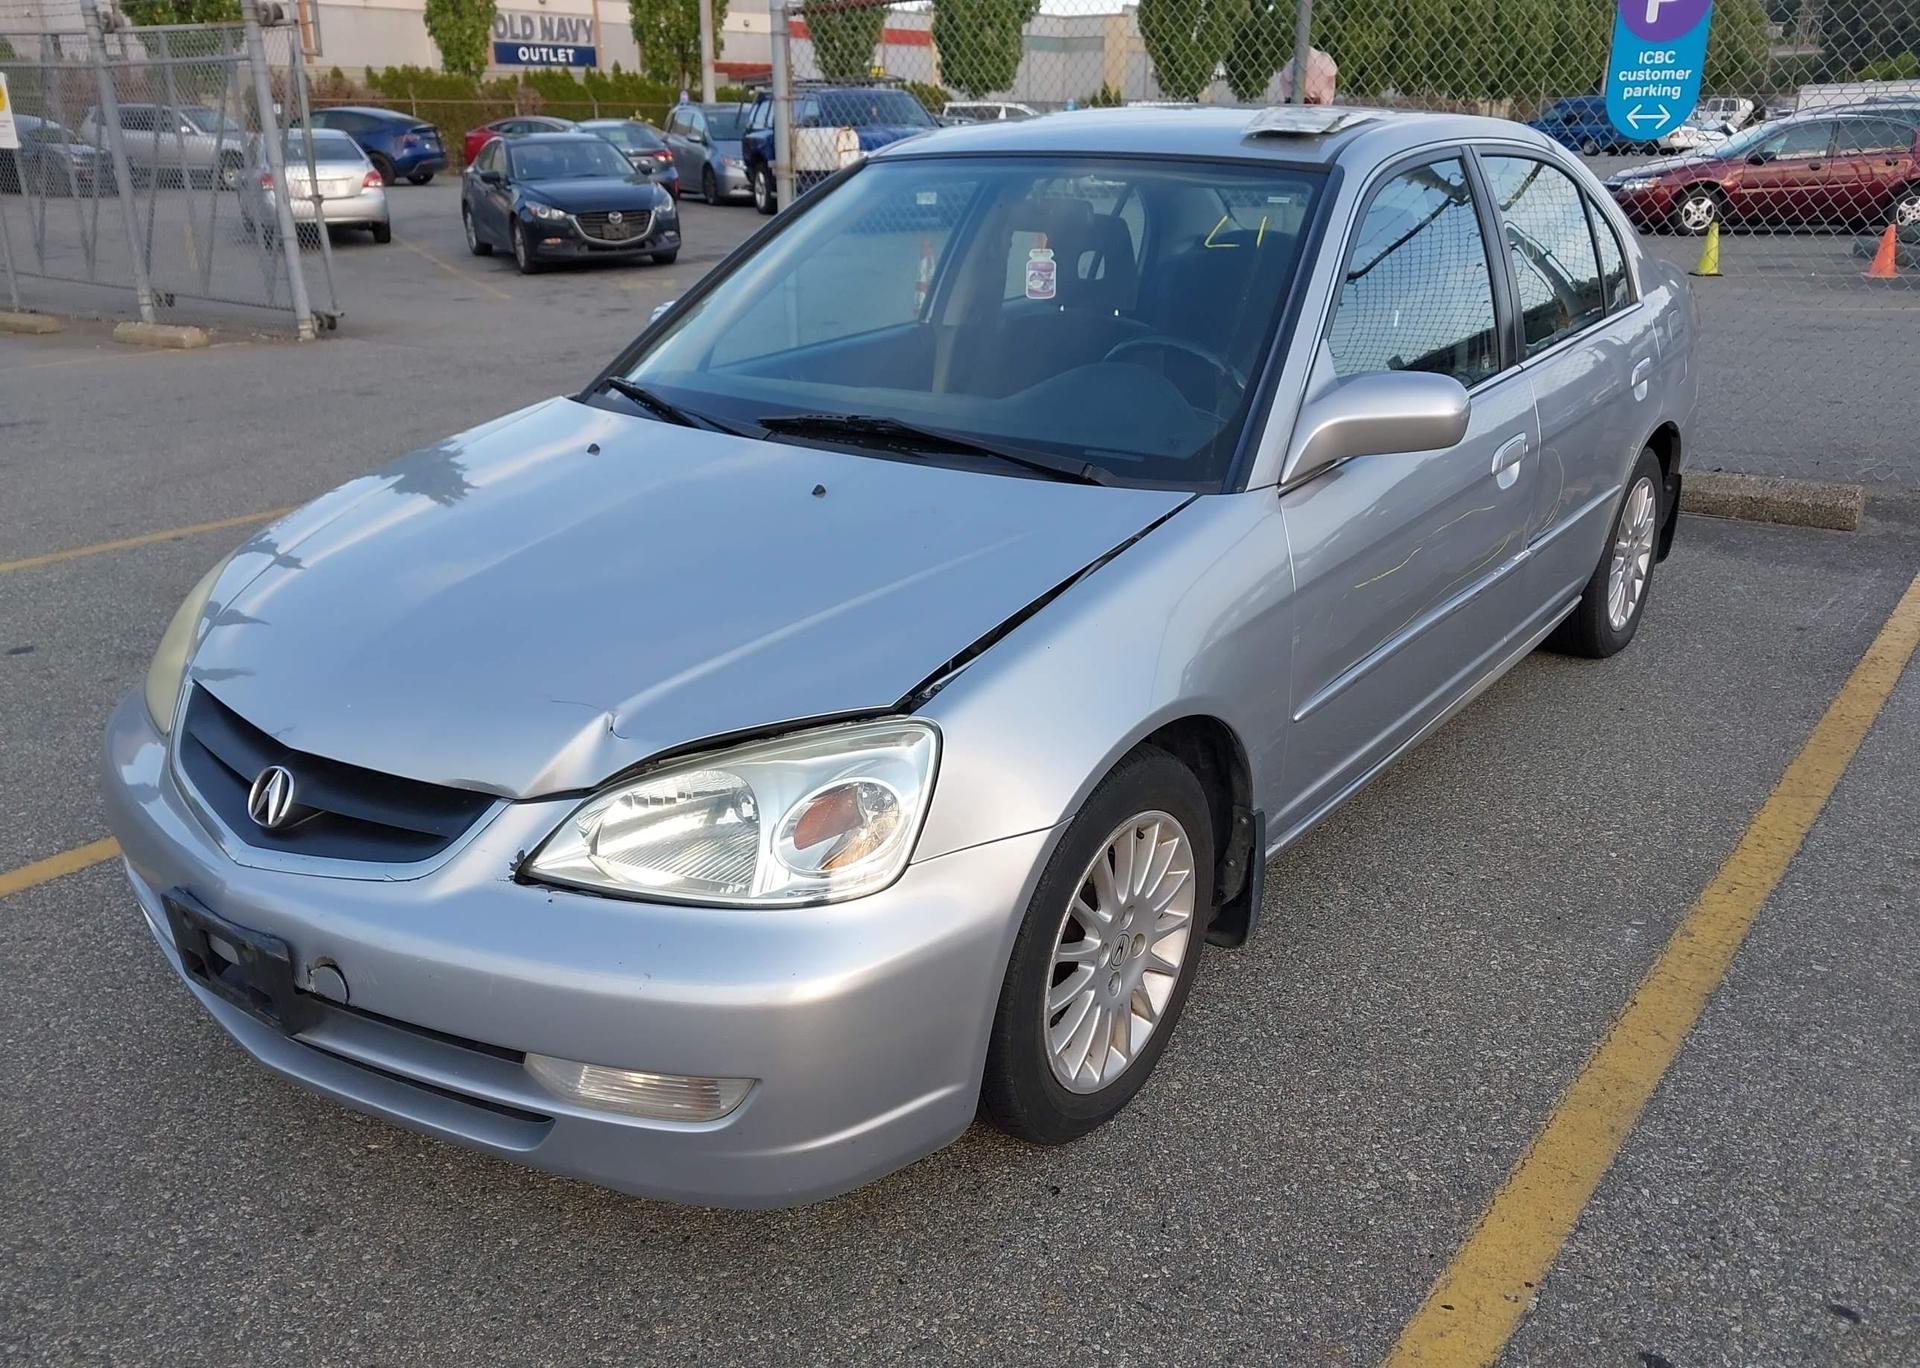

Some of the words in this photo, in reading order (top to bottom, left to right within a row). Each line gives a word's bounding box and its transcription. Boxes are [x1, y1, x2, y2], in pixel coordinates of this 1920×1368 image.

[495, 14, 535, 40] OLD
[541, 16, 592, 43] NAVY
[518, 46, 575, 63] OUTLET
[1639, 51, 1676, 64] ICBC
[1619, 68, 1692, 81] customer
[1623, 84, 1681, 100] parking
